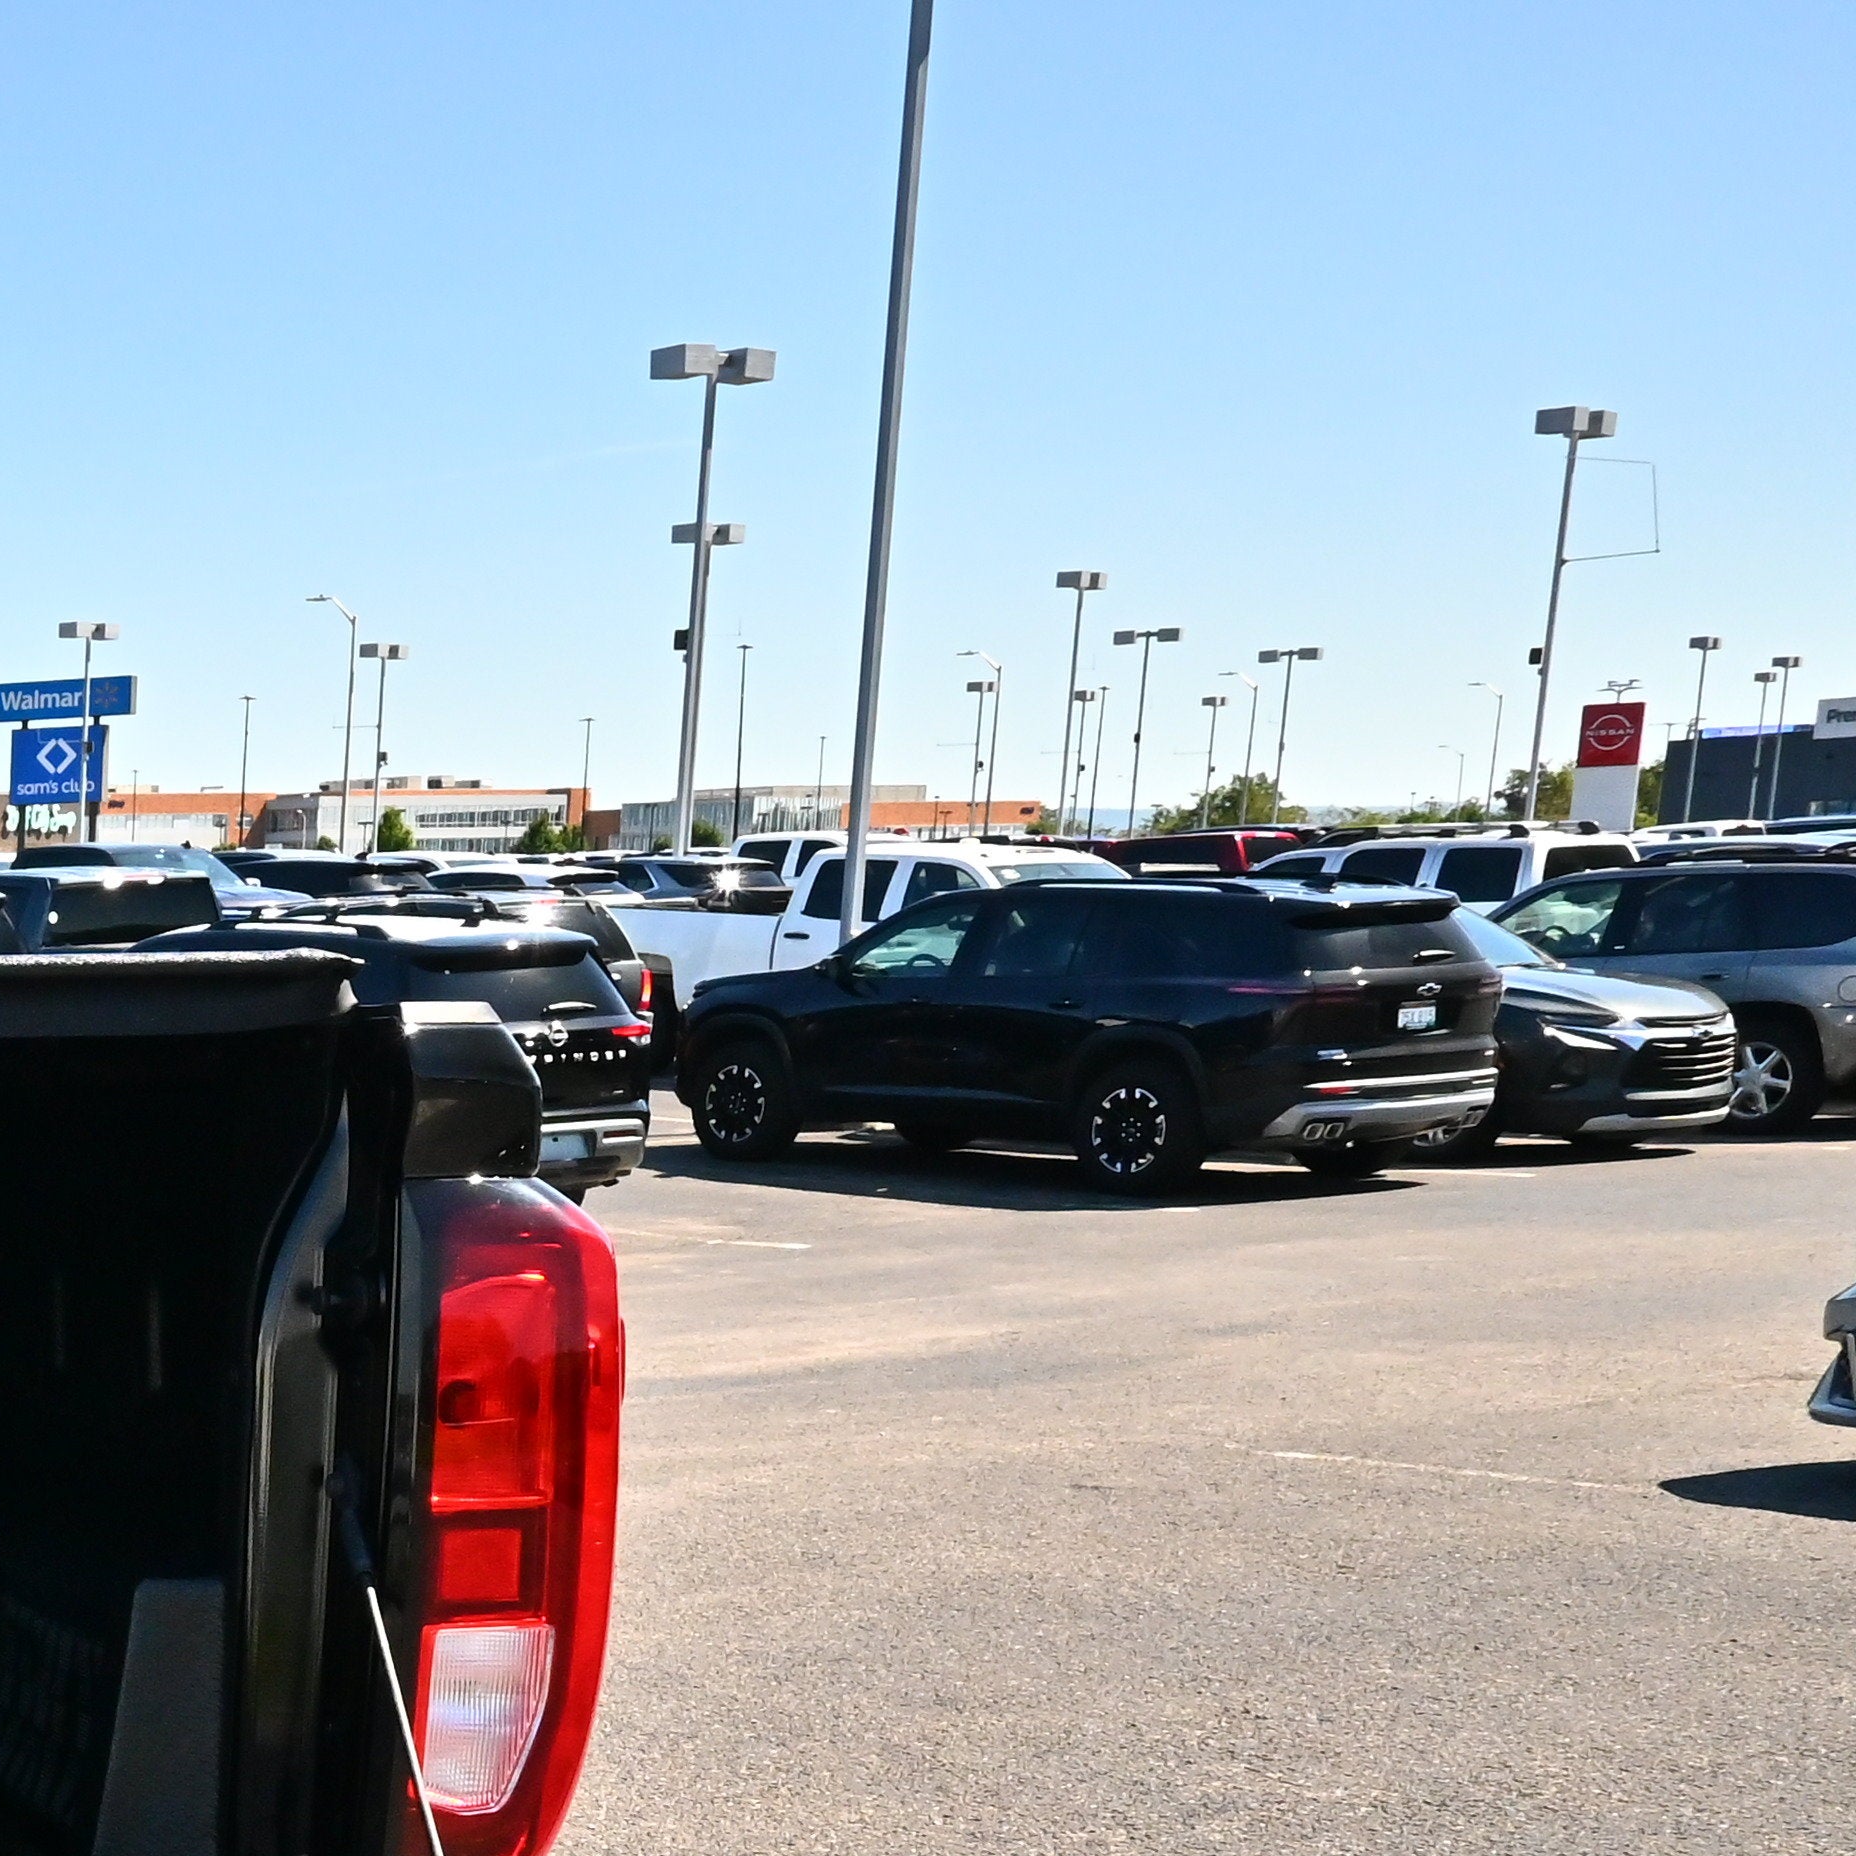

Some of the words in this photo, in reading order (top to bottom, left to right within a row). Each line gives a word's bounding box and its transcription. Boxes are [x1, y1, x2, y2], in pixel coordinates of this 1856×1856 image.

[0, 689, 84, 712] Walmar
[1585, 728, 1635, 737] NISSAN
[16, 779, 59, 796] sam's
